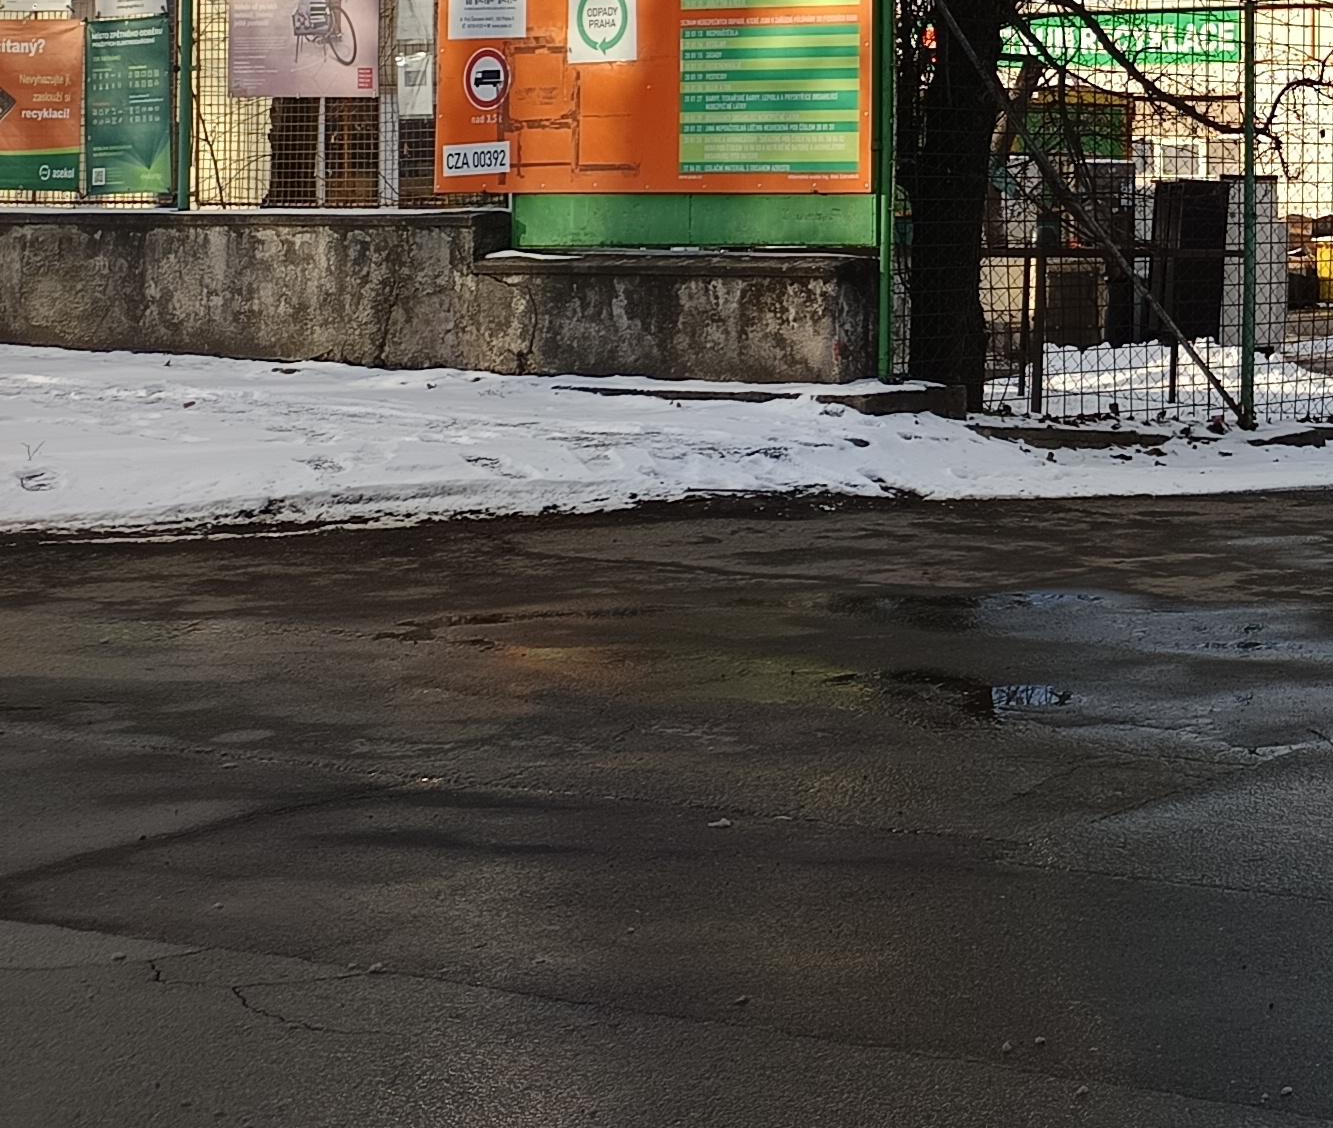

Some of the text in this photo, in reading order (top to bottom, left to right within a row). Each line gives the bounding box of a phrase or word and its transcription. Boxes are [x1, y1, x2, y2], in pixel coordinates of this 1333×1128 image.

[586, 6, 618, 18] ODPADY
[588, 18, 617, 29] PRAHA
[0, 38, 46, 57] ítaný?
[21, 107, 70, 121] recyklaci!
[446, 150, 506, 170] CZA 00392
